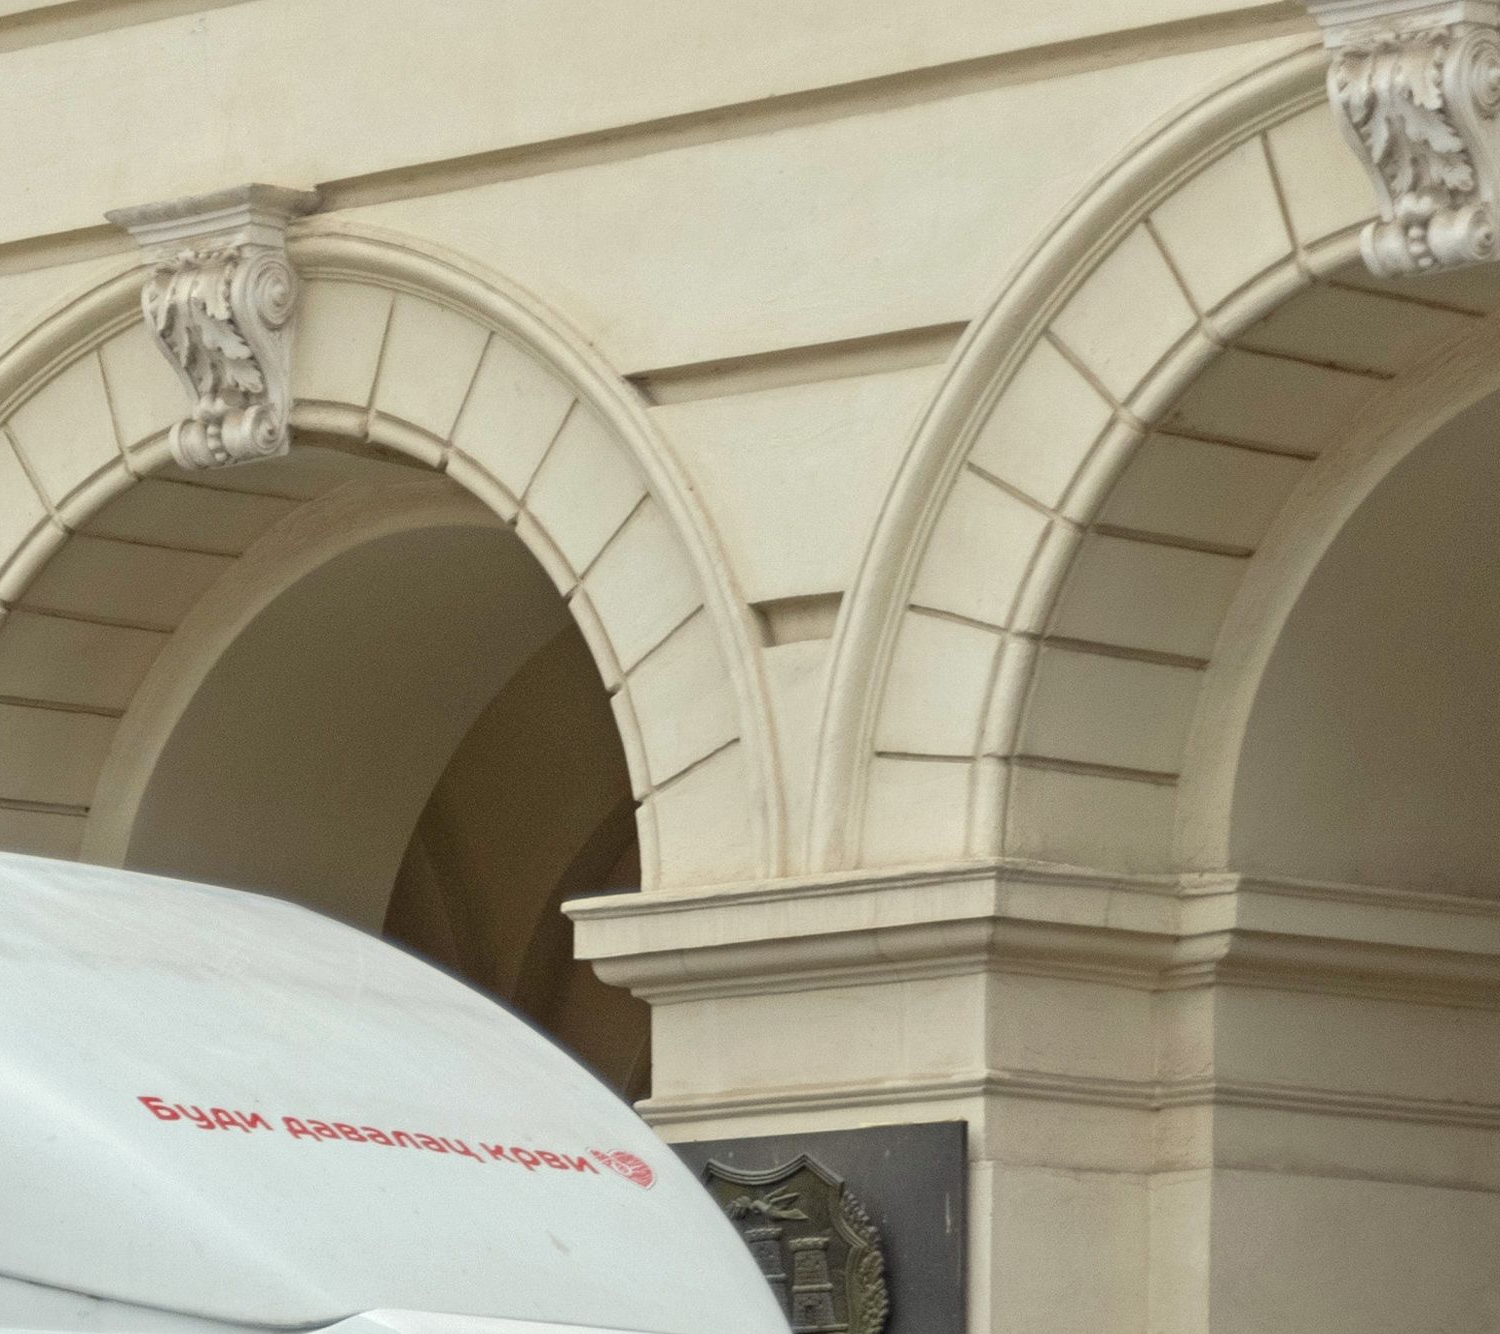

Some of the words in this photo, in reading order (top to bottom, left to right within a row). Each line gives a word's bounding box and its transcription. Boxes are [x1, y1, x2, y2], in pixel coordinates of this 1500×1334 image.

[137, 1096, 272, 1131] Буди
[281, 1115, 485, 1164] давалац
[479, 1142, 602, 1175] крви
